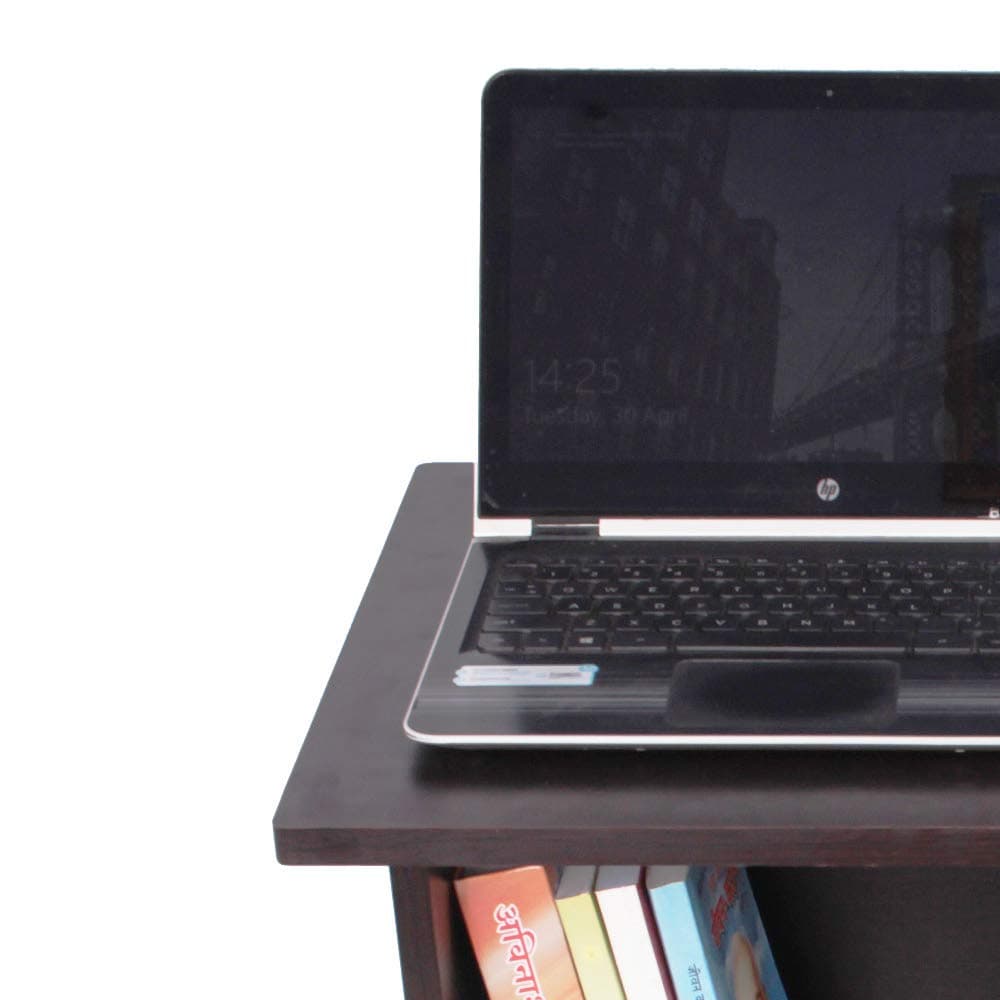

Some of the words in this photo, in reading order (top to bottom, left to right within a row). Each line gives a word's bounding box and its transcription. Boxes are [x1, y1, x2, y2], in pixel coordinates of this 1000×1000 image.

[526, 358, 624, 394] 14:25
[818, 478, 840, 501] hp
[687, 962, 703, 992] जीवन
